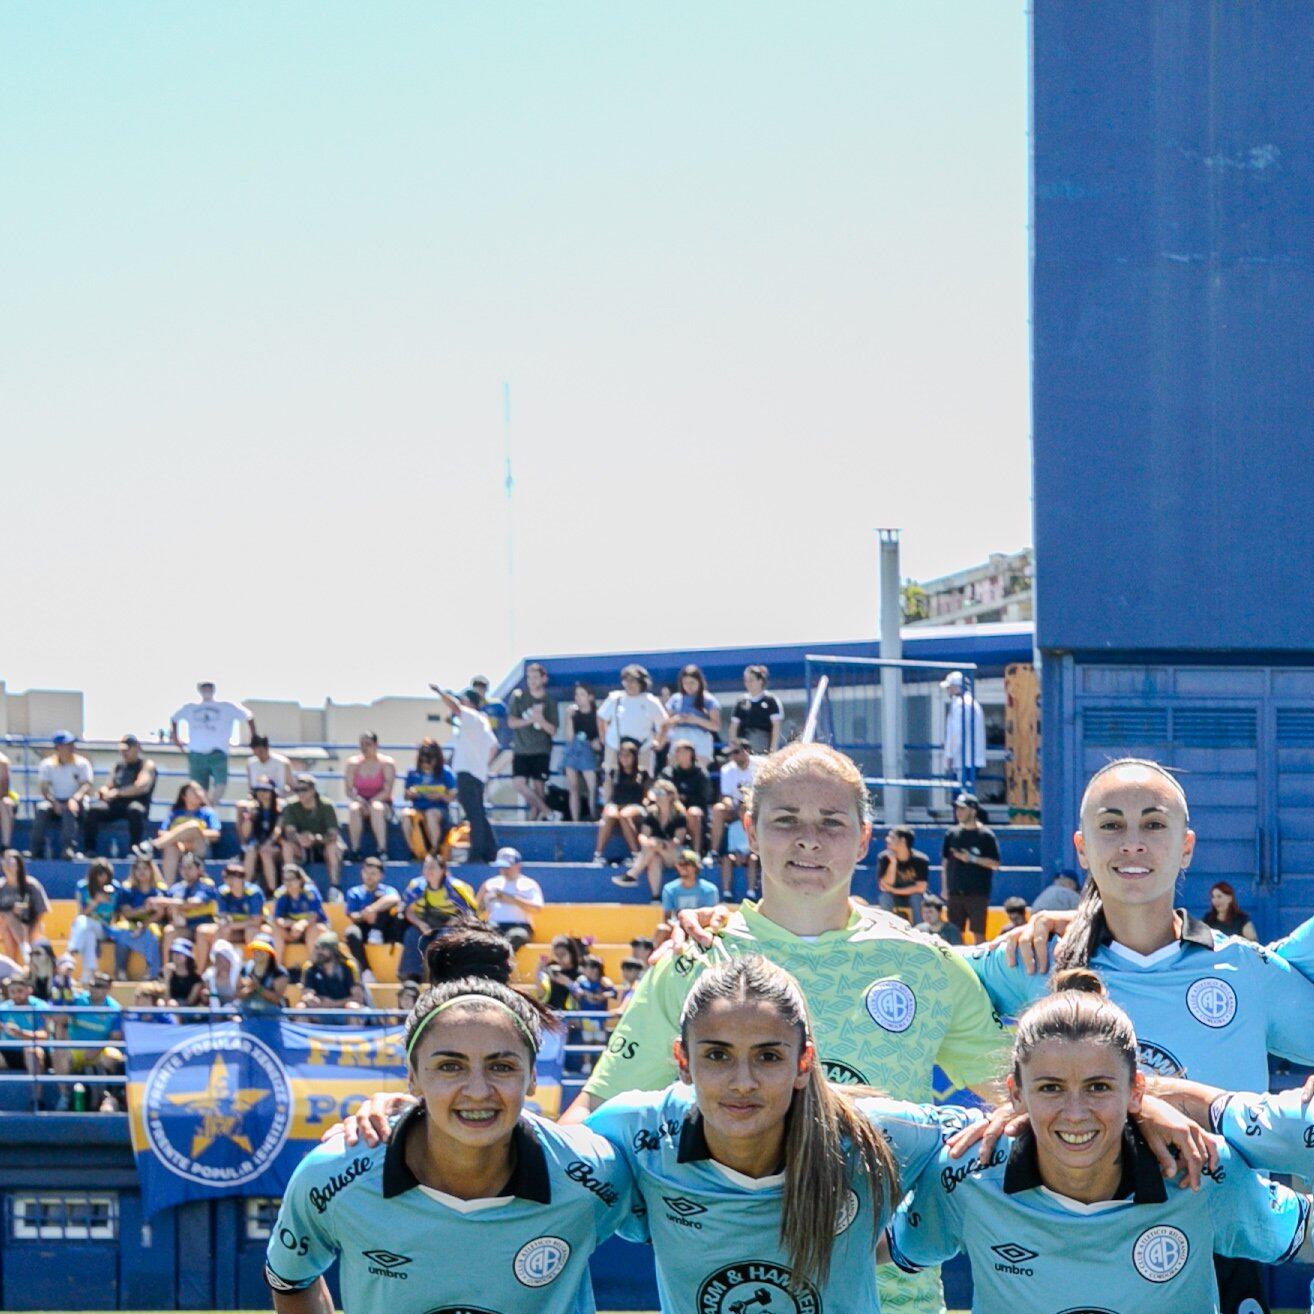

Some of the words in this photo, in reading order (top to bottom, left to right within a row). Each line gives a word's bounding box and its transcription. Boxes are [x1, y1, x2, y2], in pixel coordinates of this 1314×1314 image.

[152, 1053, 182, 1108] FRENTE
[183, 1038, 249, 1060] POPULAR
[152, 1119, 190, 1168] FRENTE
[192, 1160, 253, 1181] POPULAR
[311, 1156, 374, 1214] Batiste
[666, 1214, 703, 1230] umbro
[368, 1266, 408, 1280] umbro
[727, 1269, 745, 1283] &
[994, 1262, 1034, 1277] umbro
